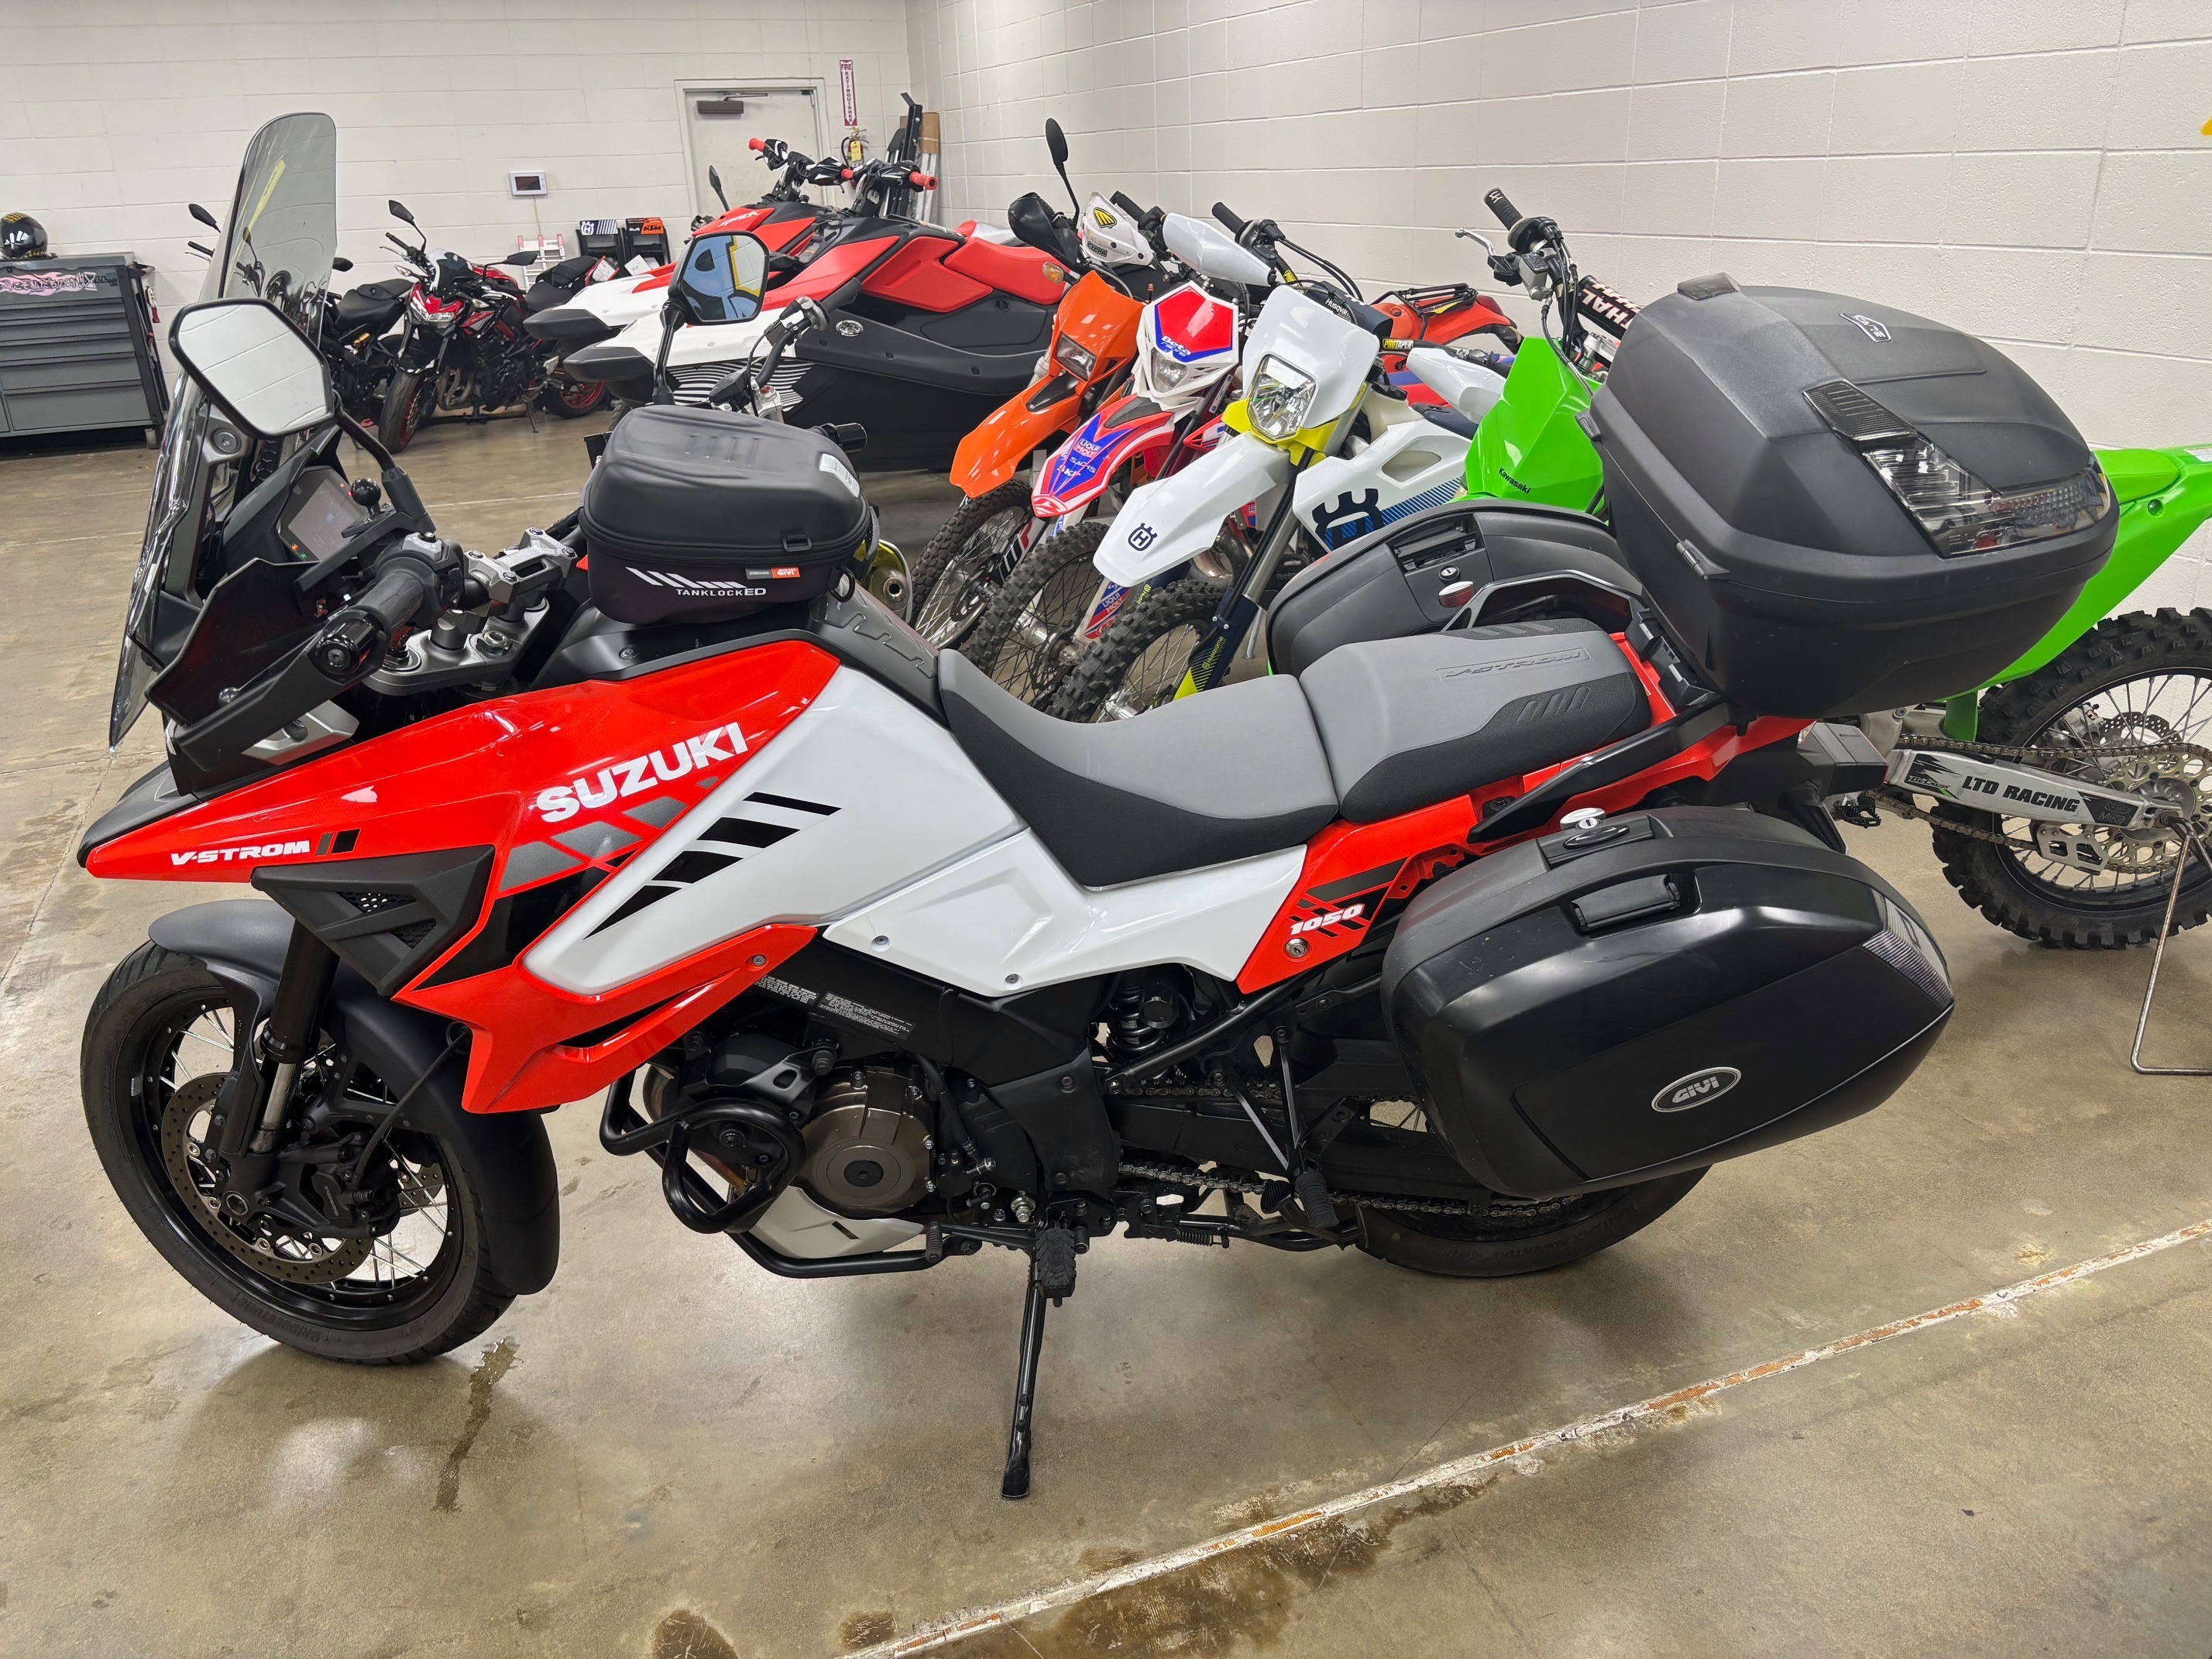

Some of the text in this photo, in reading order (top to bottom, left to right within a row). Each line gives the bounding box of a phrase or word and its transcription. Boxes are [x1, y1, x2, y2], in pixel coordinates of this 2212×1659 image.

[844, 71, 853, 122] EXTINGUISHER
[1161, 335, 1192, 356] Beta
[1076, 445, 1095, 458] MOLY
[1080, 439, 1100, 452] LIQUI
[1056, 465, 1081, 477] SKF
[1070, 456, 1097, 473] SACHS
[1499, 466, 1532, 494] Kawasaki
[777, 568, 798, 576] GIVI
[676, 587, 767, 596] TANKLOCKED
[1101, 592, 1121, 608] LIQUI
[1106, 598, 1123, 613] MOLY
[1444, 651, 1582, 678] V-STROM
[536, 721, 749, 823] SUZUKI
[1962, 775, 1999, 795] LTD
[2002, 785, 2081, 812] RACING
[170, 840, 311, 866] V-STROM
[1290, 902, 1365, 936] 1050
[1671, 1076, 1719, 1104] GIVI
